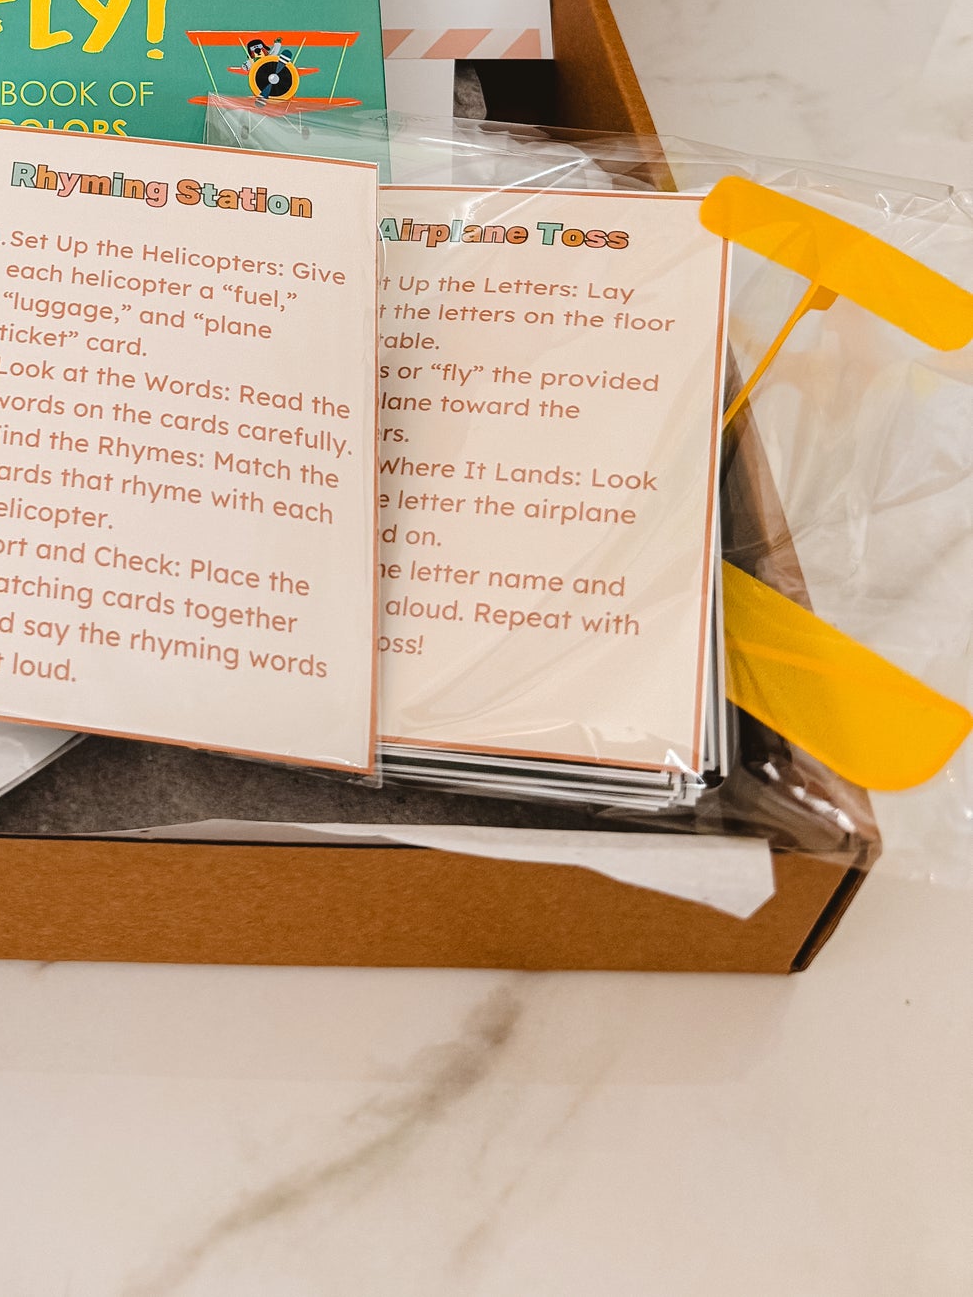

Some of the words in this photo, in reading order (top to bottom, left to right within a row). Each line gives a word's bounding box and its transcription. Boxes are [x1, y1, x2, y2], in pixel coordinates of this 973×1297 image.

[0, 81, 98, 107] BOOK
[109, 81, 154, 107] OF
[10, 161, 169, 208] Rhyming
[174, 178, 313, 219] Station
[379, 217, 529, 247] Airplane
[536, 220, 631, 250] Toss
[56, 234, 89, 259] Up
[95, 238, 134, 260] the
[142, 243, 284, 277] Helicopters:
[291, 261, 346, 286] Give
[5, 263, 63, 283] each
[70, 266, 193, 297] helicopter
[199, 285, 214, 300] a
[398, 275, 430, 296] Up
[437, 275, 476, 293] the
[483, 277, 578, 298] Letters:
[587, 282, 636, 306] Lay
[138, 309, 186, 329] and
[85, 336, 148, 357] card.
[62, 365, 90, 384] at
[96, 366, 136, 389] the
[143, 371, 231, 402] Words:
[239, 384, 303, 412] Read
[310, 395, 351, 420] the
[396, 365, 424, 380] or
[491, 365, 533, 385] the
[539, 369, 660, 392] provided
[439, 395, 531, 417] toward
[538, 399, 581, 420] the
[48, 430, 90, 454] the
[98, 435, 205, 469] Rhymes:
[214, 450, 291, 481] Match
[299, 463, 340, 489] the
[463, 460, 487, 481] It
[495, 462, 582, 487] Lands:
[591, 467, 658, 492] Look
[35, 542, 86, 564] and
[94, 545, 181, 578] Check:
[190, 558, 261, 589] Place
[268, 570, 311, 597] the
[102, 589, 175, 616] cards
[183, 597, 299, 634] together
[385, 595, 464, 622] aloud.
[473, 602, 573, 632] Repeat
[581, 611, 640, 636] with
[12, 651, 76, 683] loud.
